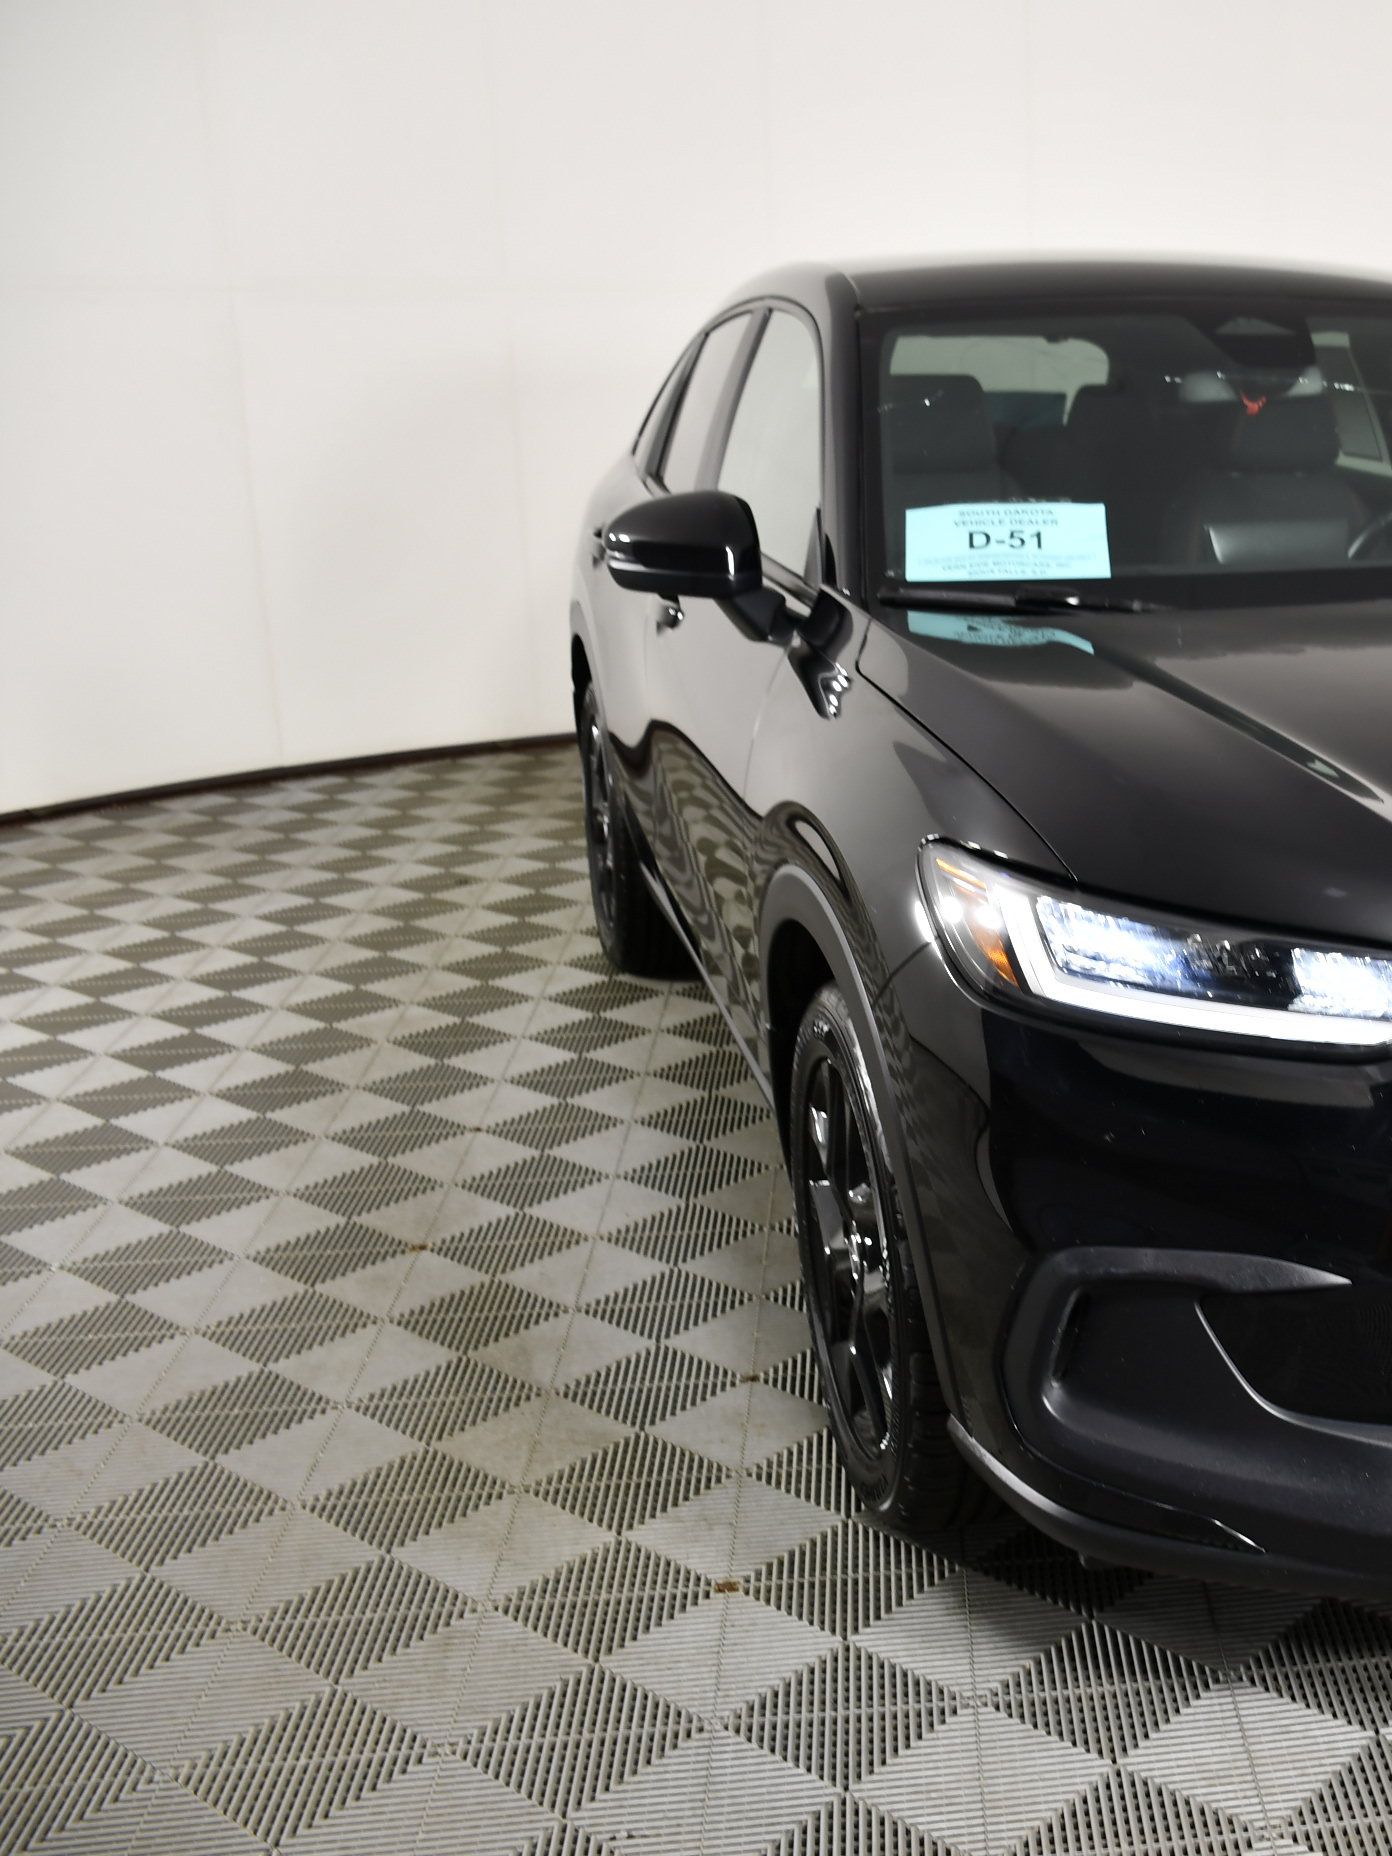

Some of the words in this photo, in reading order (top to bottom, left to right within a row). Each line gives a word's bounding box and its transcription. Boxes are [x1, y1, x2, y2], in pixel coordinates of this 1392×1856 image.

[1005, 508, 1054, 516] DAKOTA
[954, 519, 1005, 527] VEHICLE
[1010, 518, 1058, 526] DEALER
[968, 530, 1042, 549] D-51
